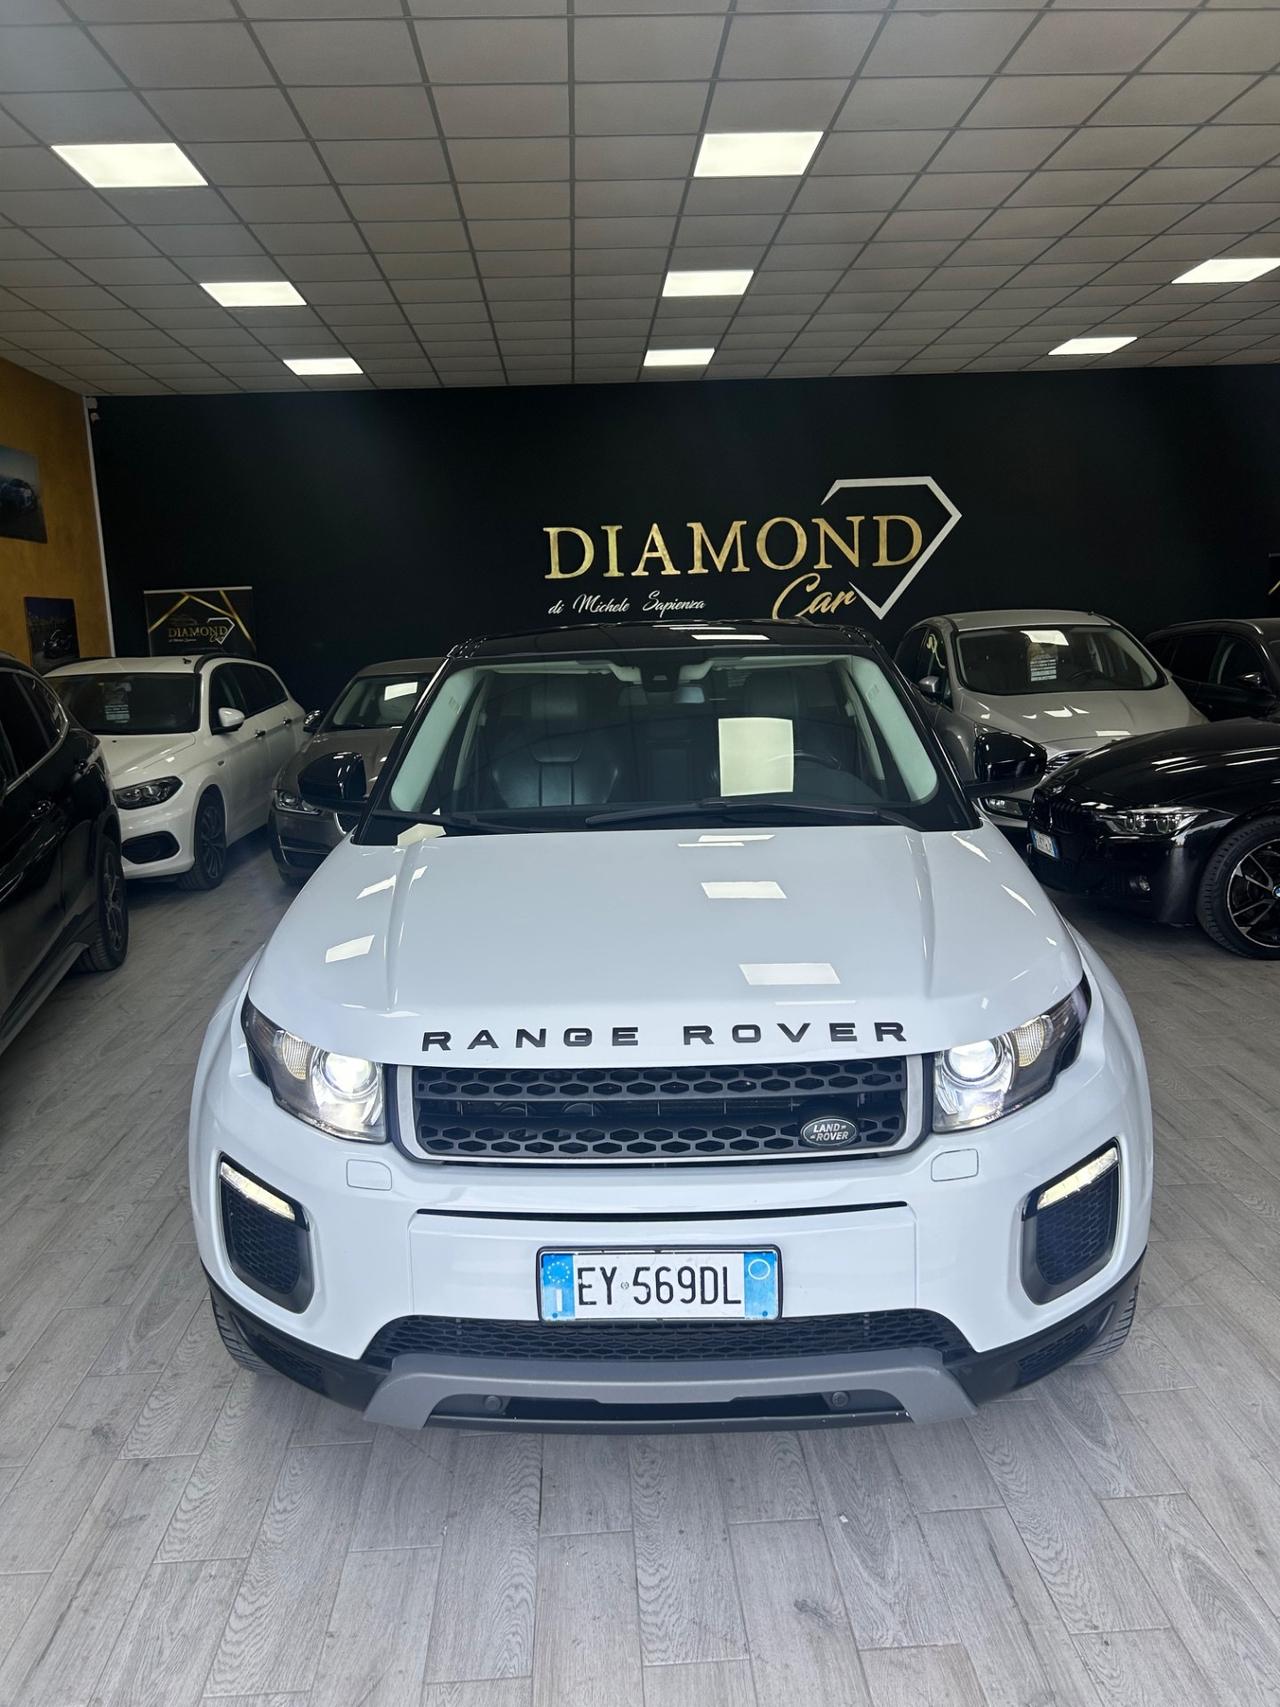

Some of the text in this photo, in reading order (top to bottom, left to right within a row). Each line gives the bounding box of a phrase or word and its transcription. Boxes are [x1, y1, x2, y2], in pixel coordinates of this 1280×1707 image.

[543, 515, 923, 579] DIAMOND
[548, 590, 707, 618] di Michele Sapienza
[772, 573, 857, 620] Car
[168, 625, 228, 638] DIAMOND
[421, 1022, 907, 1052] RANGE ROVER
[813, 1123, 840, 1133] LAND
[816, 1131, 849, 1141] ROVER
[577, 1266, 742, 1305] EY 569DL
